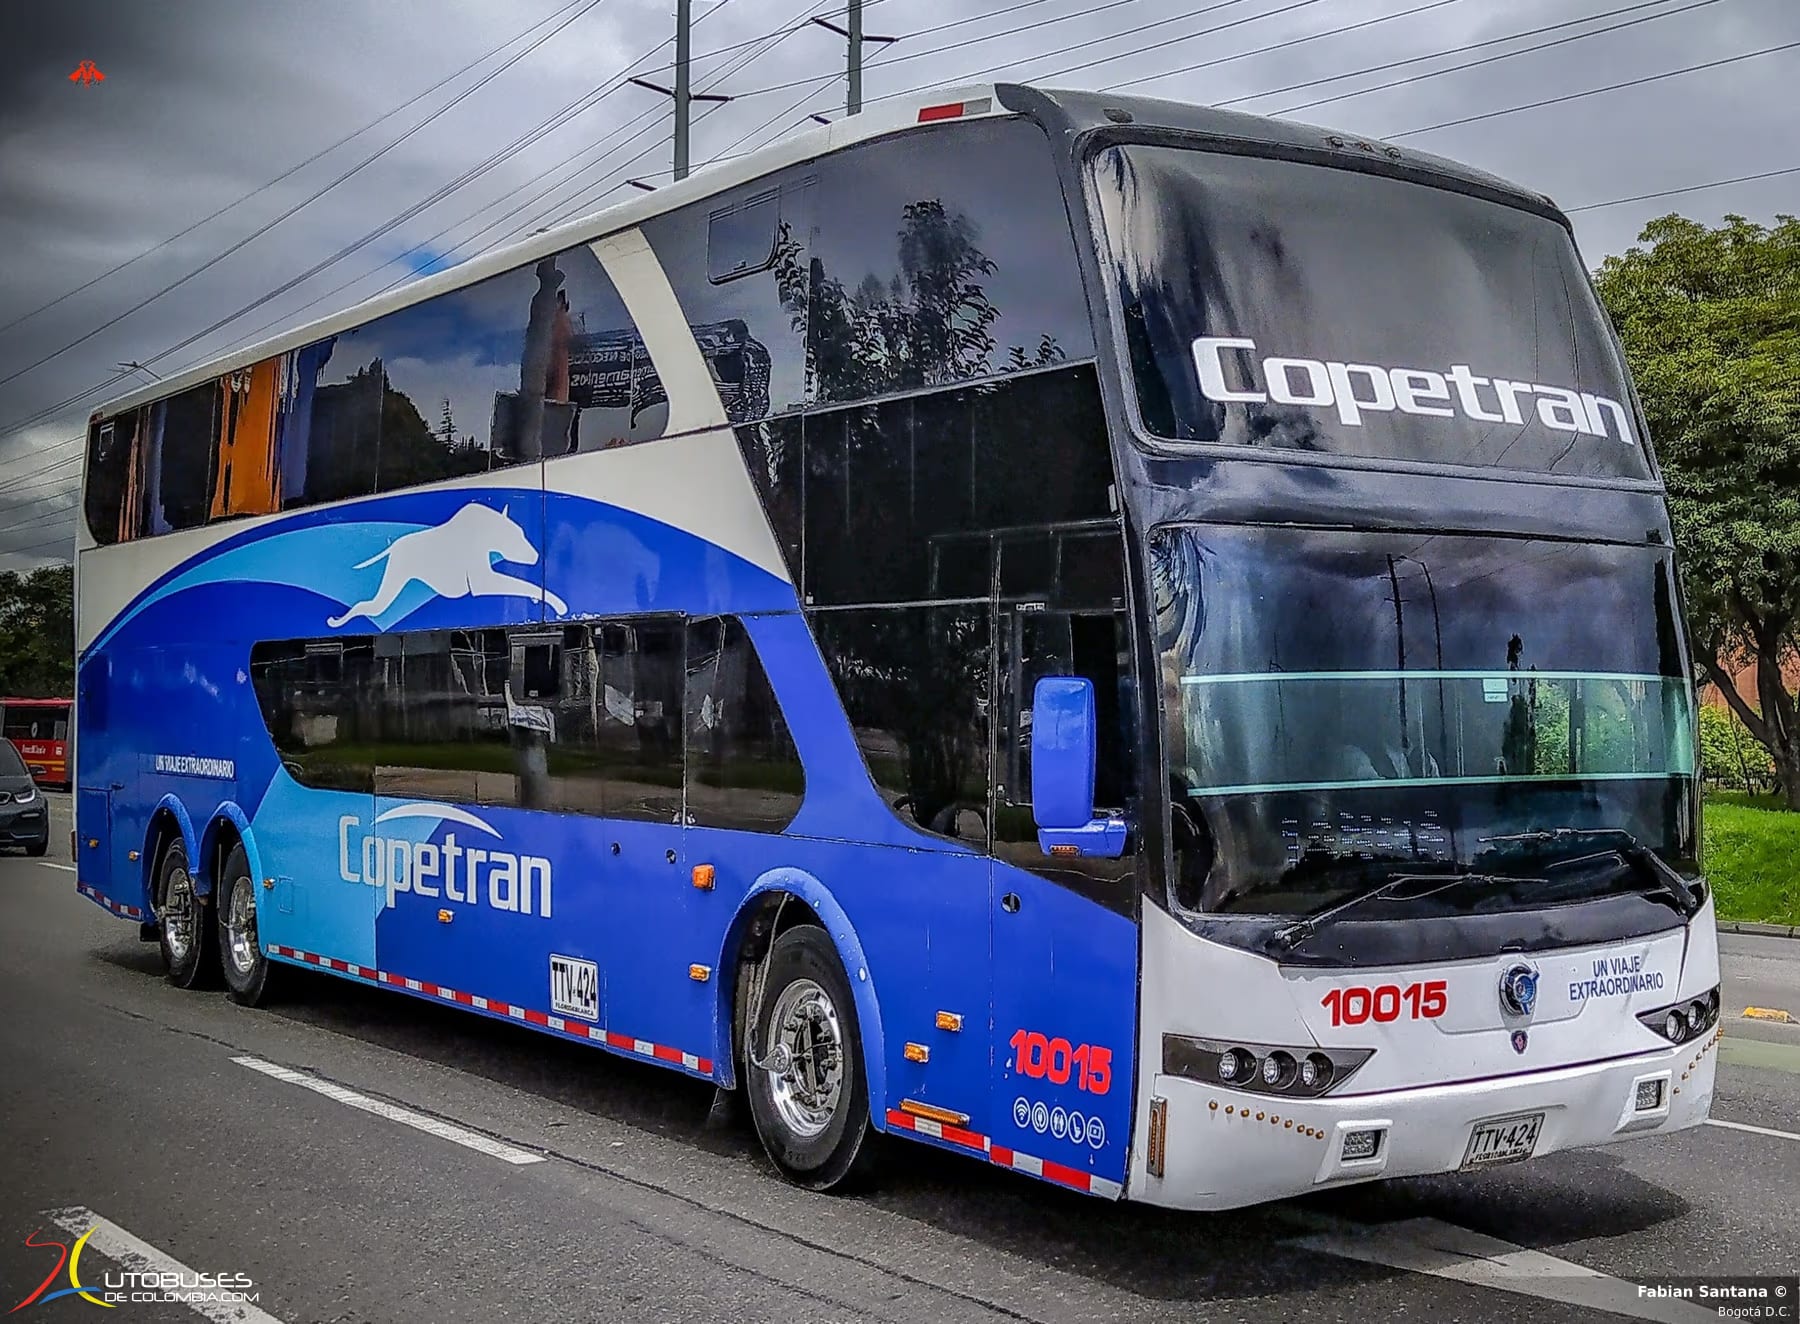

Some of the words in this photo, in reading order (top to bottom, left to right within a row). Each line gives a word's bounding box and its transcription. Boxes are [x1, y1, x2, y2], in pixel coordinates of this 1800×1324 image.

[1192, 336, 1635, 445] Copetran
[181, 756, 235, 778] EXTRAORDINARIO
[340, 815, 552, 919] Copetran
[1569, 972, 1664, 1001] EXTRAORDINARIO
[1592, 959, 1609, 977] UN
[1611, 955, 1641, 975] VIAJE
[1321, 980, 1448, 1028] 10015
[1010, 1029, 1112, 1095] 10015
